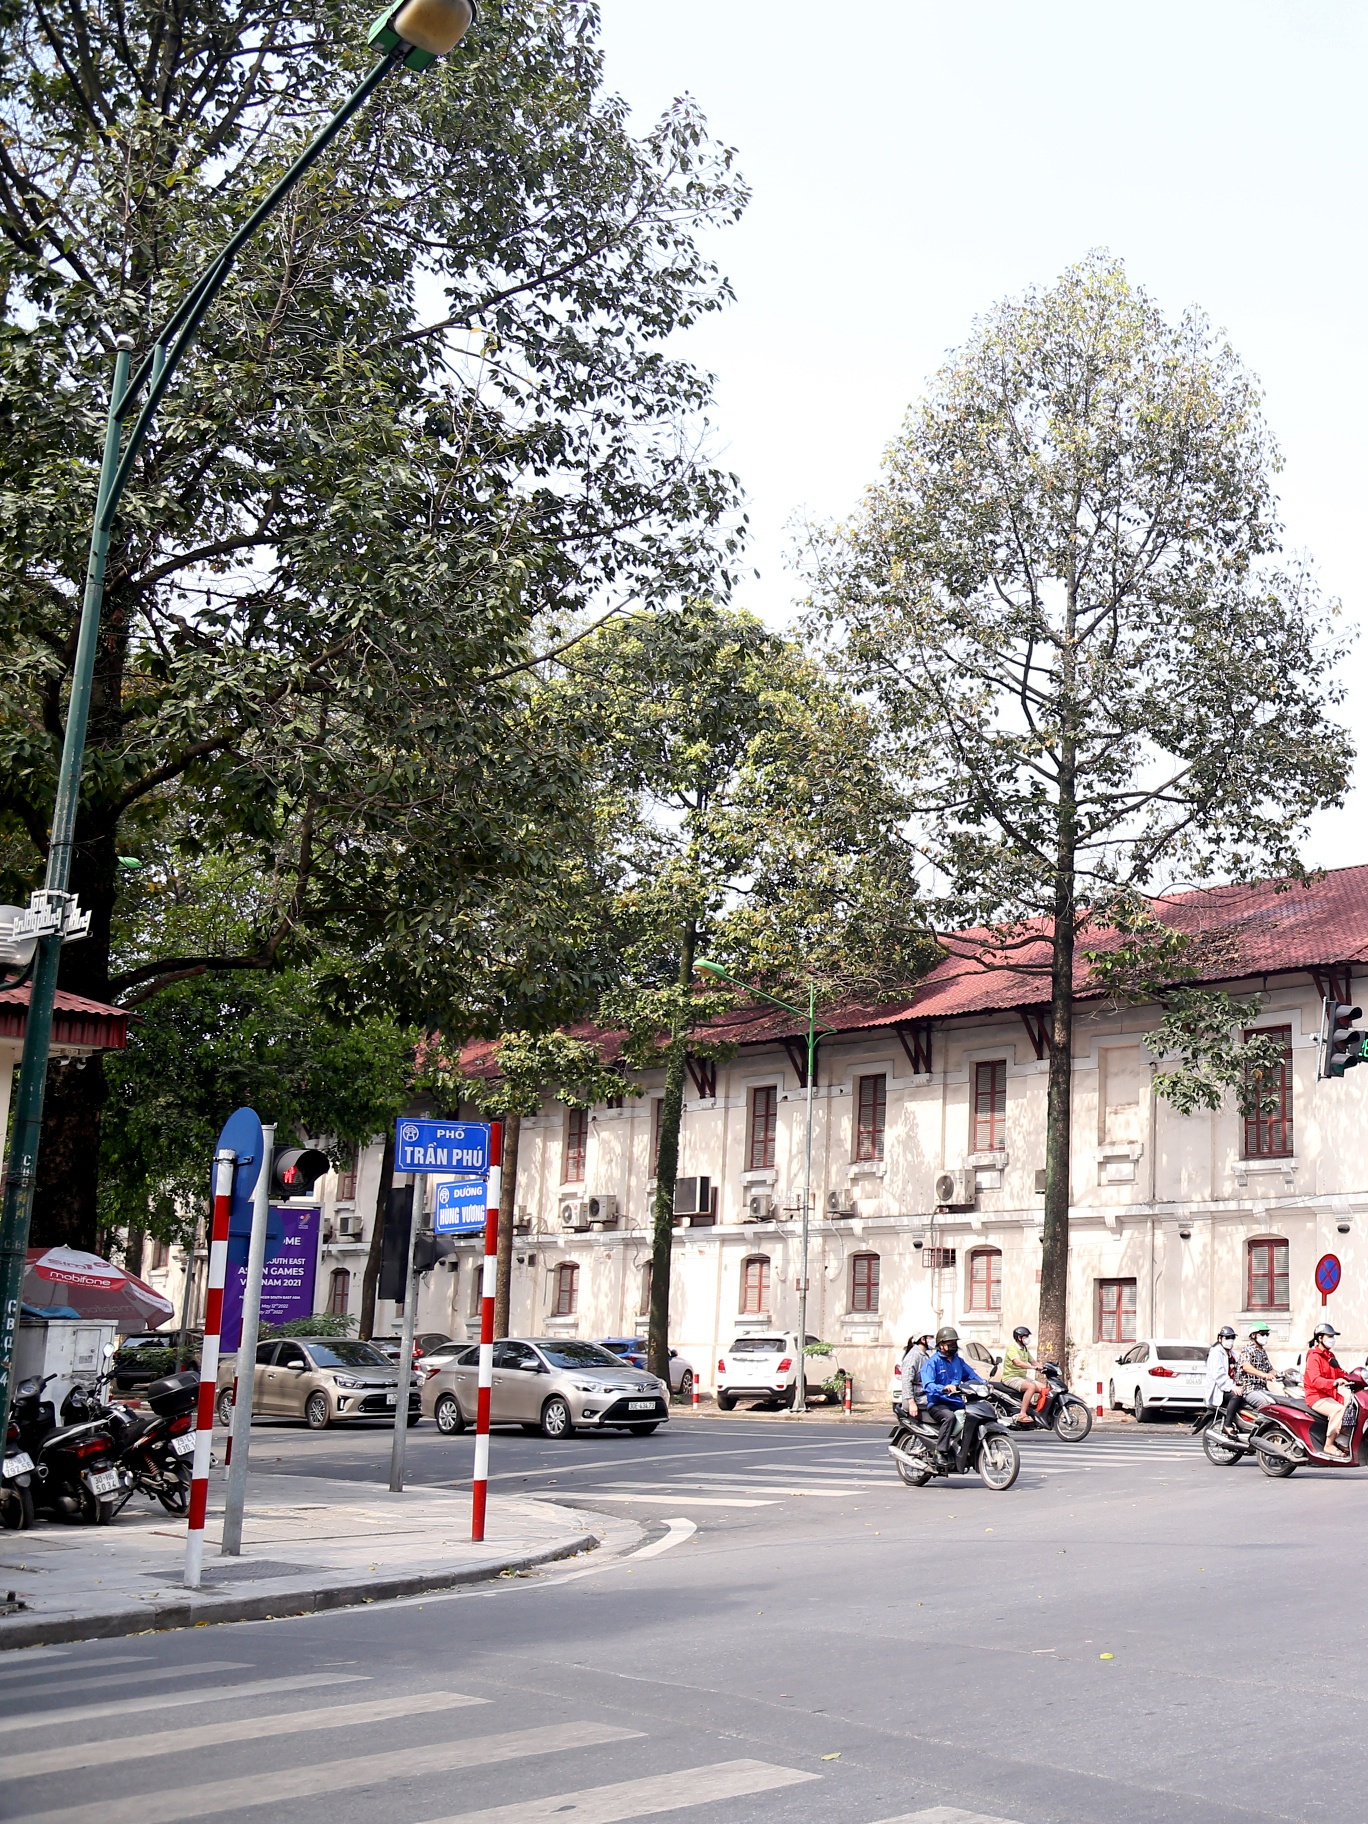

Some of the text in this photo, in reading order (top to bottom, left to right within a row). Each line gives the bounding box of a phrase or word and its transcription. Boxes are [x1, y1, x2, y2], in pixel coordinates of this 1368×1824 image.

[436, 1127, 466, 1139] PHỐ
[404, 1142, 483, 1167] TRẦN PHÚ
[453, 1185, 483, 1198] ĐƯỜNG
[439, 1203, 485, 1226] HÙNG VƯƠNG
[270, 1267, 304, 1276] GAMES
[50, 1271, 111, 1286] mobifone
[282, 1279, 302, 1287] 2021
[5, 1456, 27, 1468] 29-B1
[5, 1462, 33, 1477] 292.56
[95, 1480, 118, 1493] 5034
